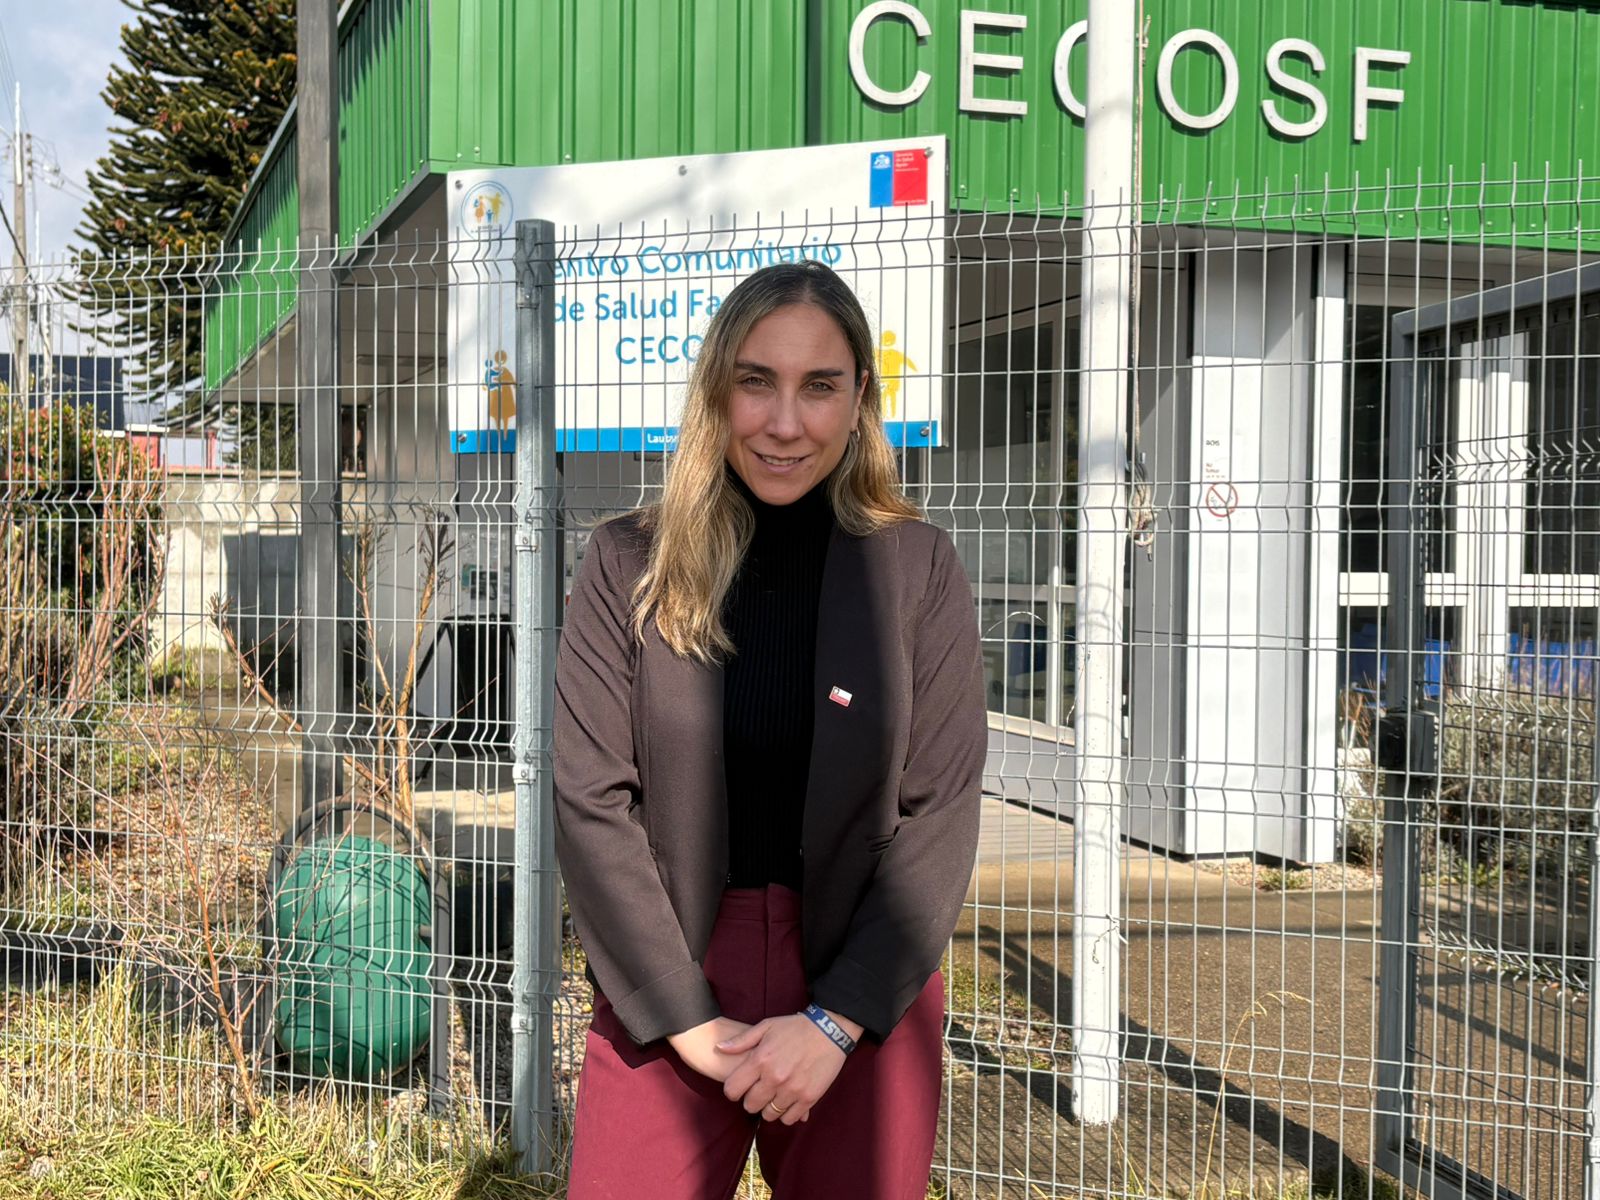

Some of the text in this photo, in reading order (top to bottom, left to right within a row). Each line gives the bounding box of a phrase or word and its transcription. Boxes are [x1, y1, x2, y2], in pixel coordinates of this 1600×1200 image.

[555, 236, 842, 279] entro Comunitario
[555, 295, 585, 322] de
[595, 290, 677, 321] Salud
[615, 334, 704, 365] CECO
[815, 1015, 852, 1049] KAST
